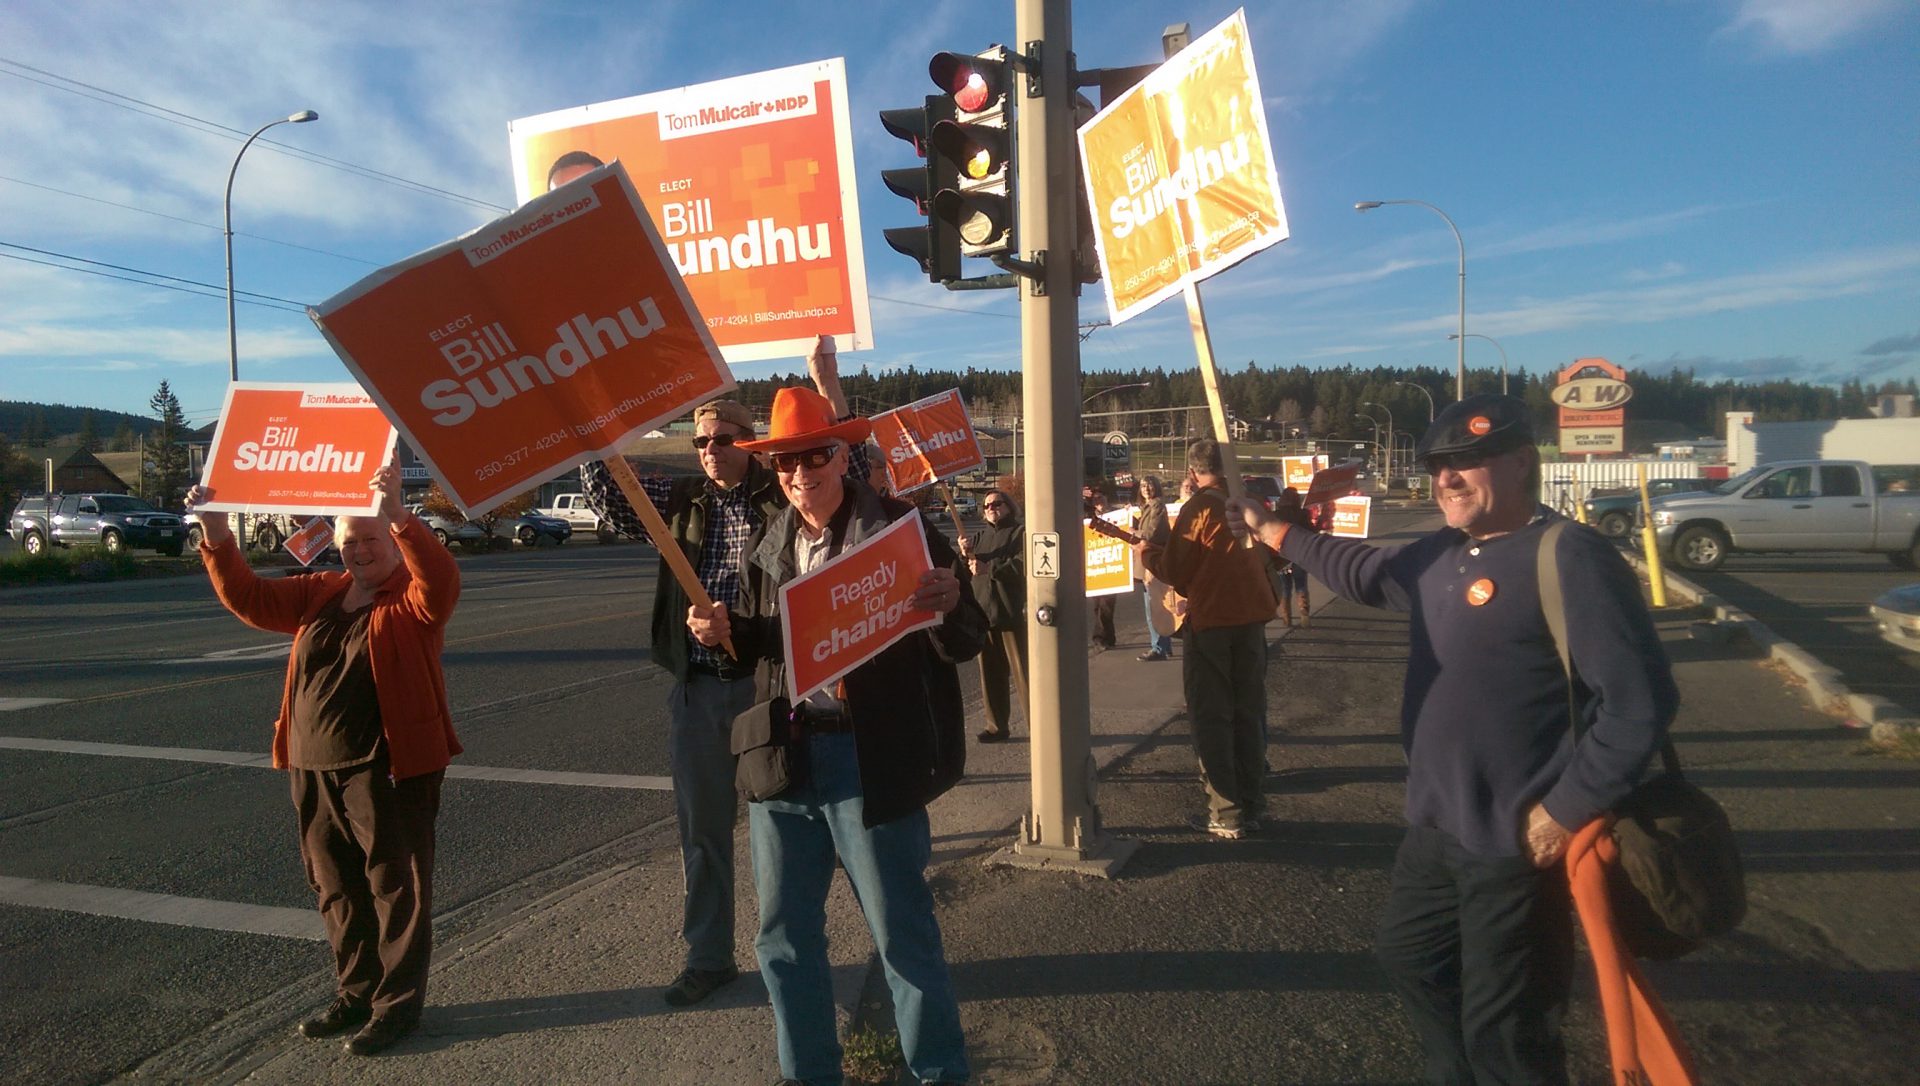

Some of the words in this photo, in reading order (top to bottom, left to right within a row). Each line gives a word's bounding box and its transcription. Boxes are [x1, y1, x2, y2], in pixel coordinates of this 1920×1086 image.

[665, 114, 698, 131] Tom
[699, 101, 763, 126] Mulcair
[775, 94, 809, 113] NDP
[1122, 141, 1145, 164] ELECT
[660, 178, 692, 193] ELECT
[1110, 133, 1251, 239] Sundhu
[1125, 149, 1158, 195] Bill
[472, 238, 503, 261] Tom
[499, 211, 557, 246] Mulcair
[562, 196, 593, 216] NDP
[662, 198, 713, 238] Bill
[668, 218, 832, 277] undhu
[429, 314, 475, 342] ELECT
[706, 315, 748, 328] -377-4204
[755, 306, 838, 323] BillSundhu.ndp.ca
[420, 296, 667, 427] Sundhu
[439, 322, 519, 377] Bill
[306, 394, 325, 404] Tom
[326, 395, 361, 404] Mulcair
[262, 426, 299, 447] Bill
[474, 428, 569, 482] 250-377-4204
[576, 370, 695, 437] BillSundhu.ndp.ca
[233, 441, 365, 473] Sundhu
[891, 428, 967, 464] Sundhu
[1289, 473, 1313, 484] Sund
[1088, 543, 1124, 567] DEFEAT
[830, 560, 897, 610] Ready
[863, 591, 887, 615] for
